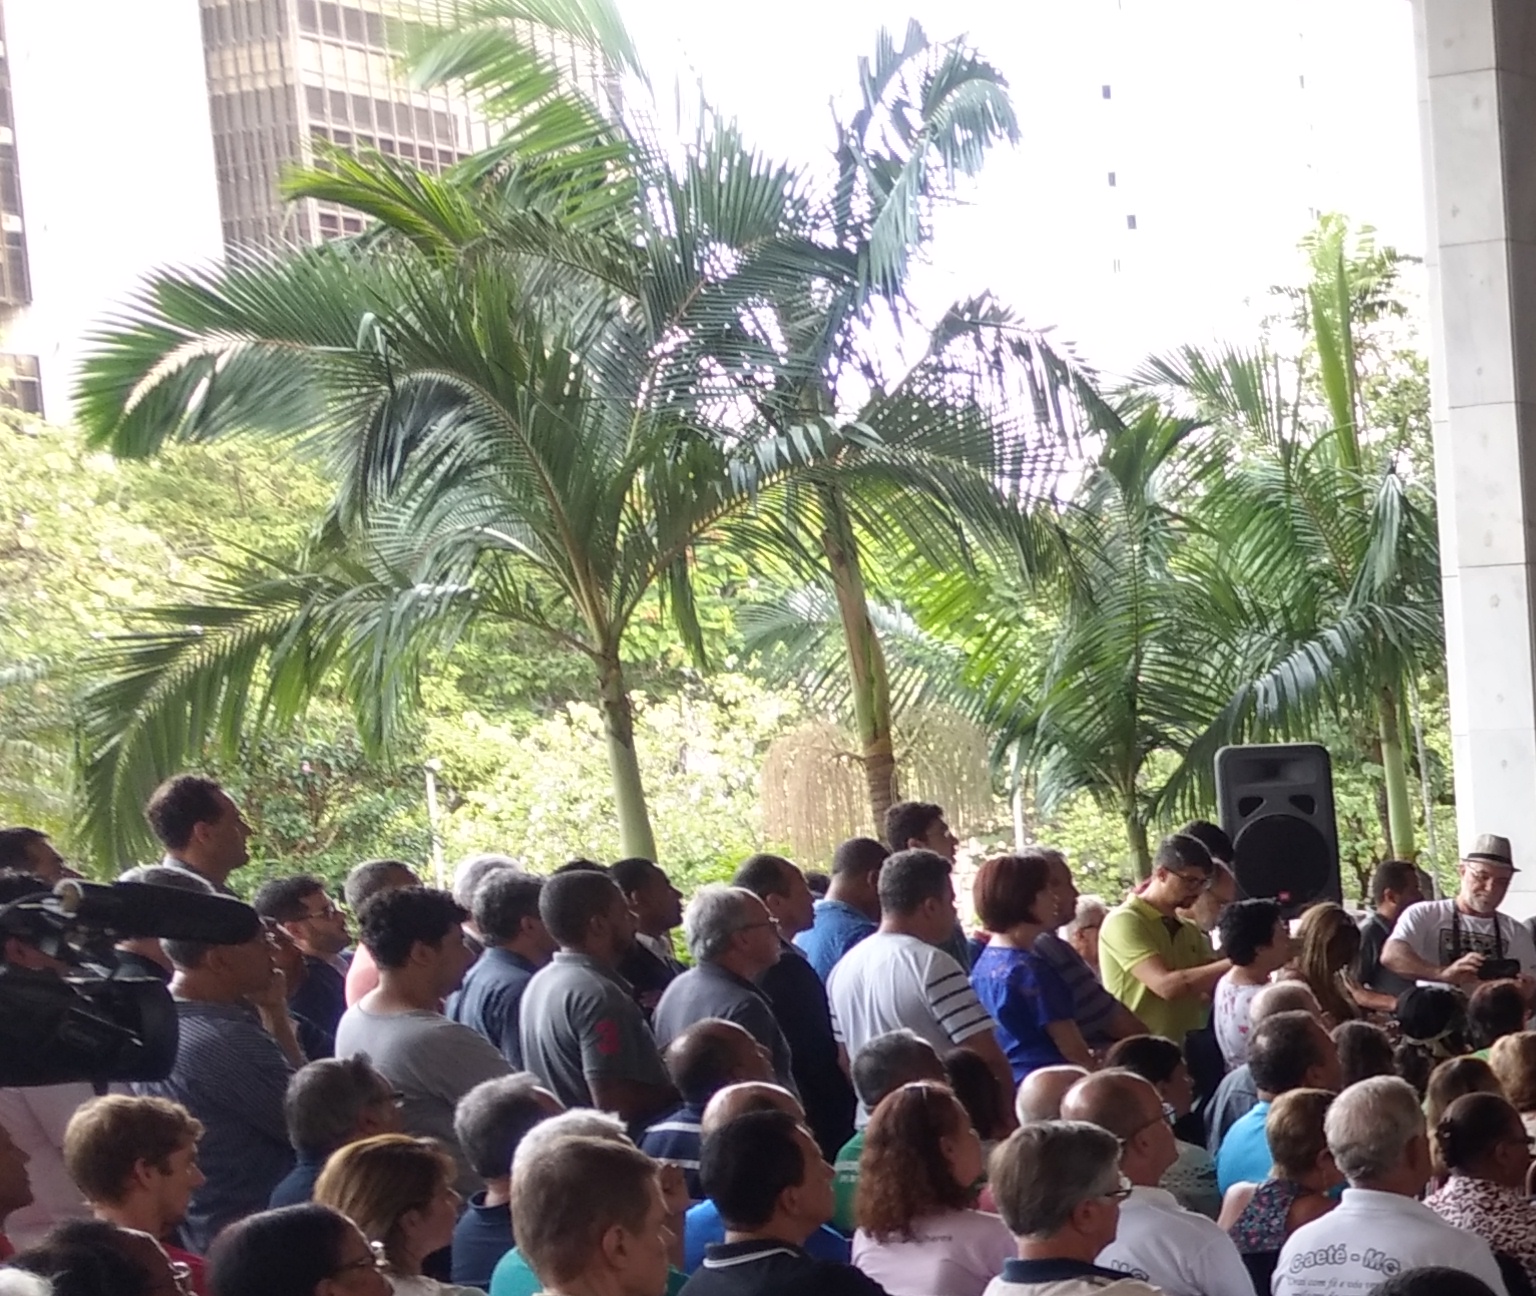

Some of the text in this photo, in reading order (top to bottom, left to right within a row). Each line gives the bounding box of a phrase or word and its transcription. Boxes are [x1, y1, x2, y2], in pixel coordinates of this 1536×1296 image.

[595, 1017, 621, 1055] 3
[1290, 1243, 1346, 1273] Caeté
[1362, 1247, 1402, 1278] MG
